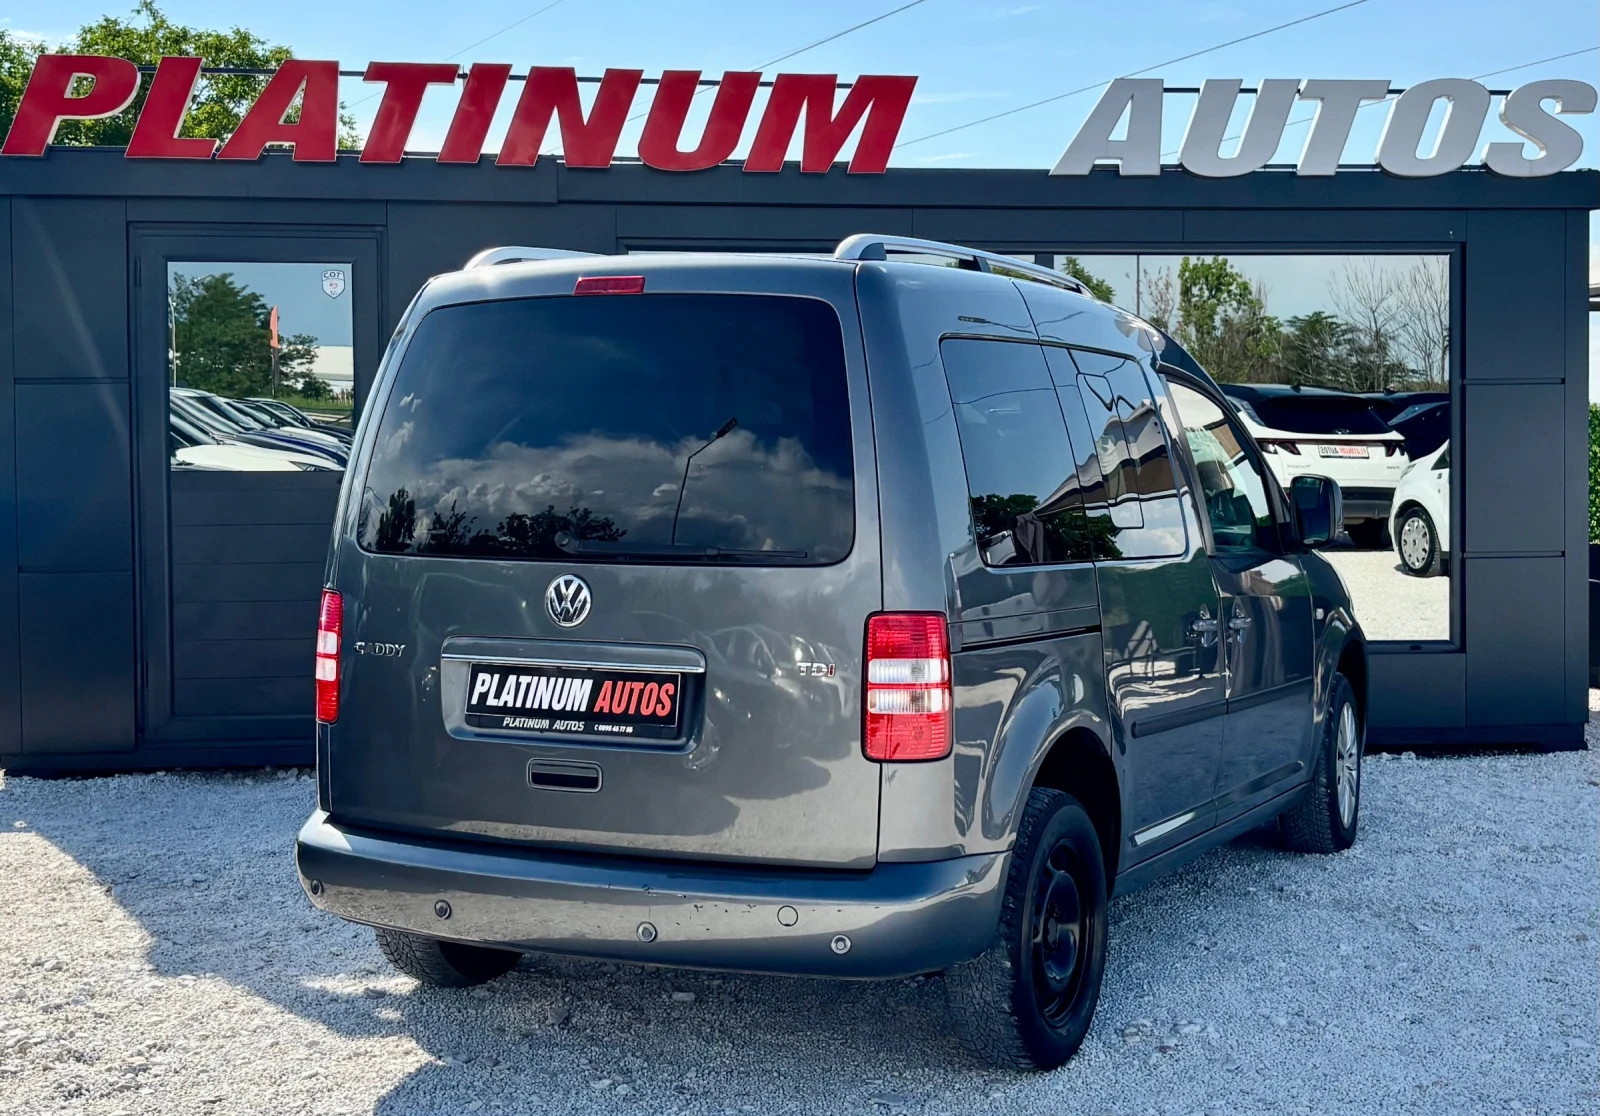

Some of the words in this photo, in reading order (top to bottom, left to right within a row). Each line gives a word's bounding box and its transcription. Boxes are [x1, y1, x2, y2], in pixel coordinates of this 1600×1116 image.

[1, 54, 918, 174] PLATINUM
[1049, 78, 1598, 178] AUTOS
[471, 672, 593, 712] PLATINUM
[594, 680, 675, 717] AUTOS
[503, 717, 549, 729] PLATINUM
[552, 720, 585, 731] AUTOS
